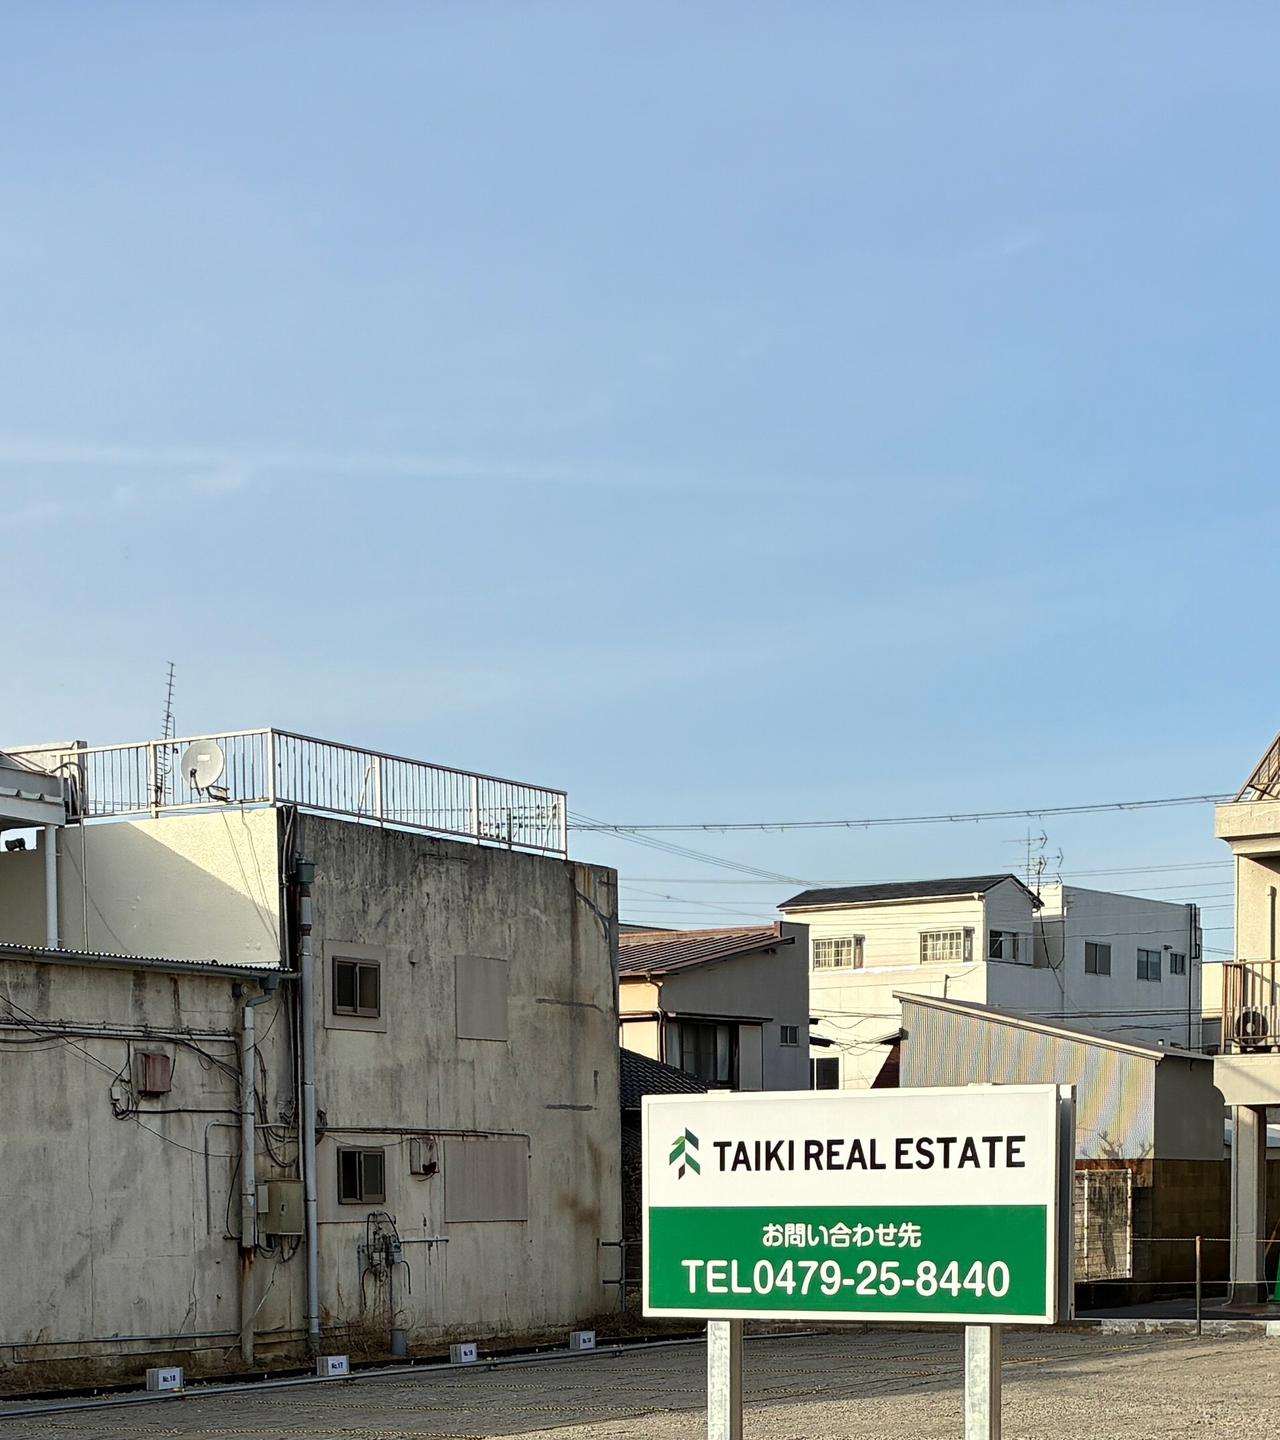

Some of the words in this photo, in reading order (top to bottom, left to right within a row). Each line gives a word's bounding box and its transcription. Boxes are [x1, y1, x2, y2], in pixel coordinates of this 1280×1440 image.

[713, 1140, 795, 1172] TAIKI
[804, 1138, 886, 1171] REAL
[895, 1135, 1026, 1170] ESTATE
[762, 1221, 922, 1248] お問い合わせ先
[681, 1259, 1010, 1297] TEL0479-25-8440
